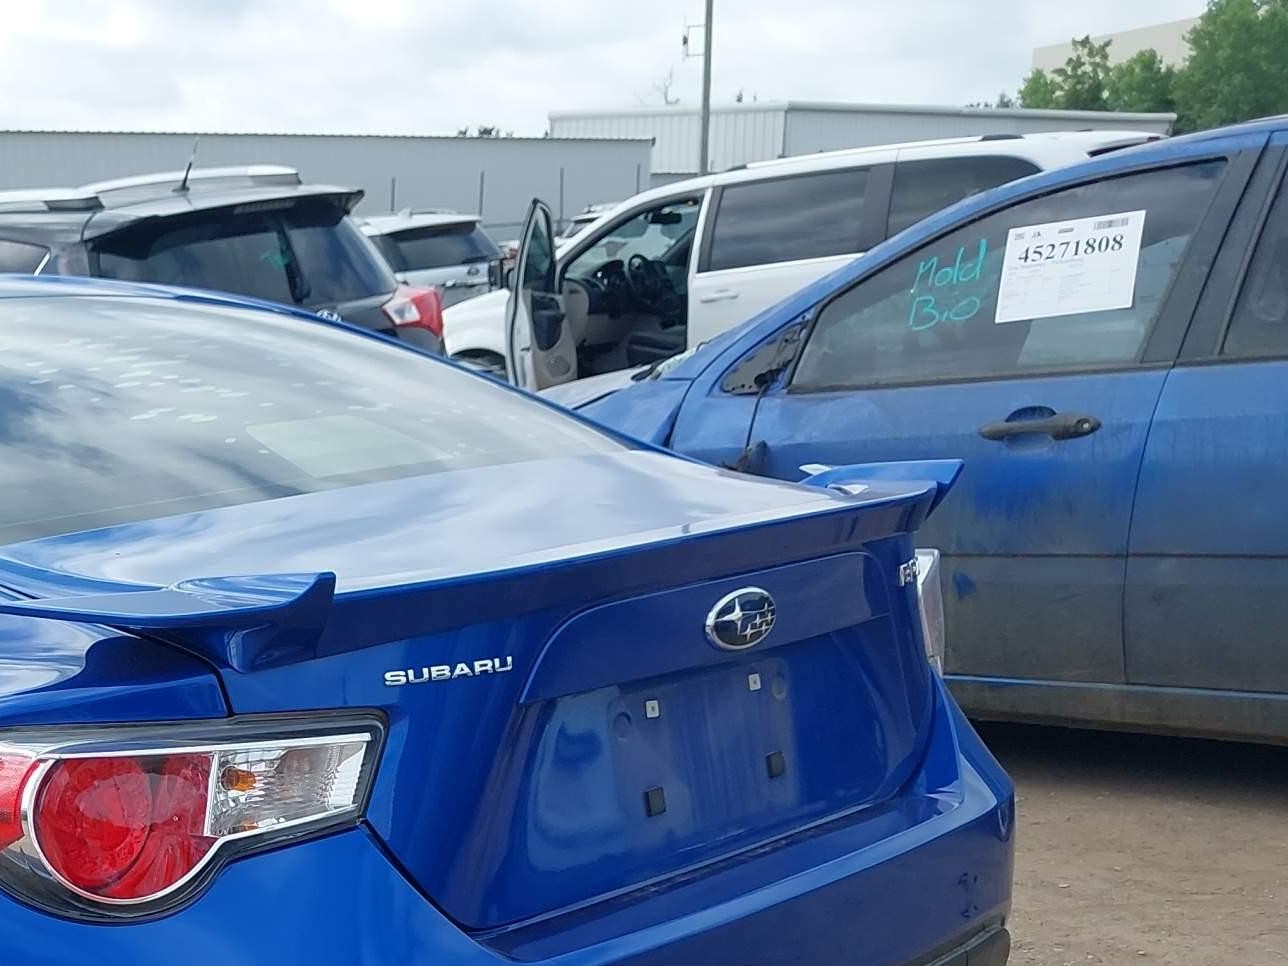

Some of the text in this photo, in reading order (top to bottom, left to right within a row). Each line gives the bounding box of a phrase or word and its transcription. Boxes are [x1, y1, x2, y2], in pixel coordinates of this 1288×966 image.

[1018, 234, 1124, 263] 45271808
[910, 239, 987, 294] Mold
[384, 656, 512, 686] SUBARU
